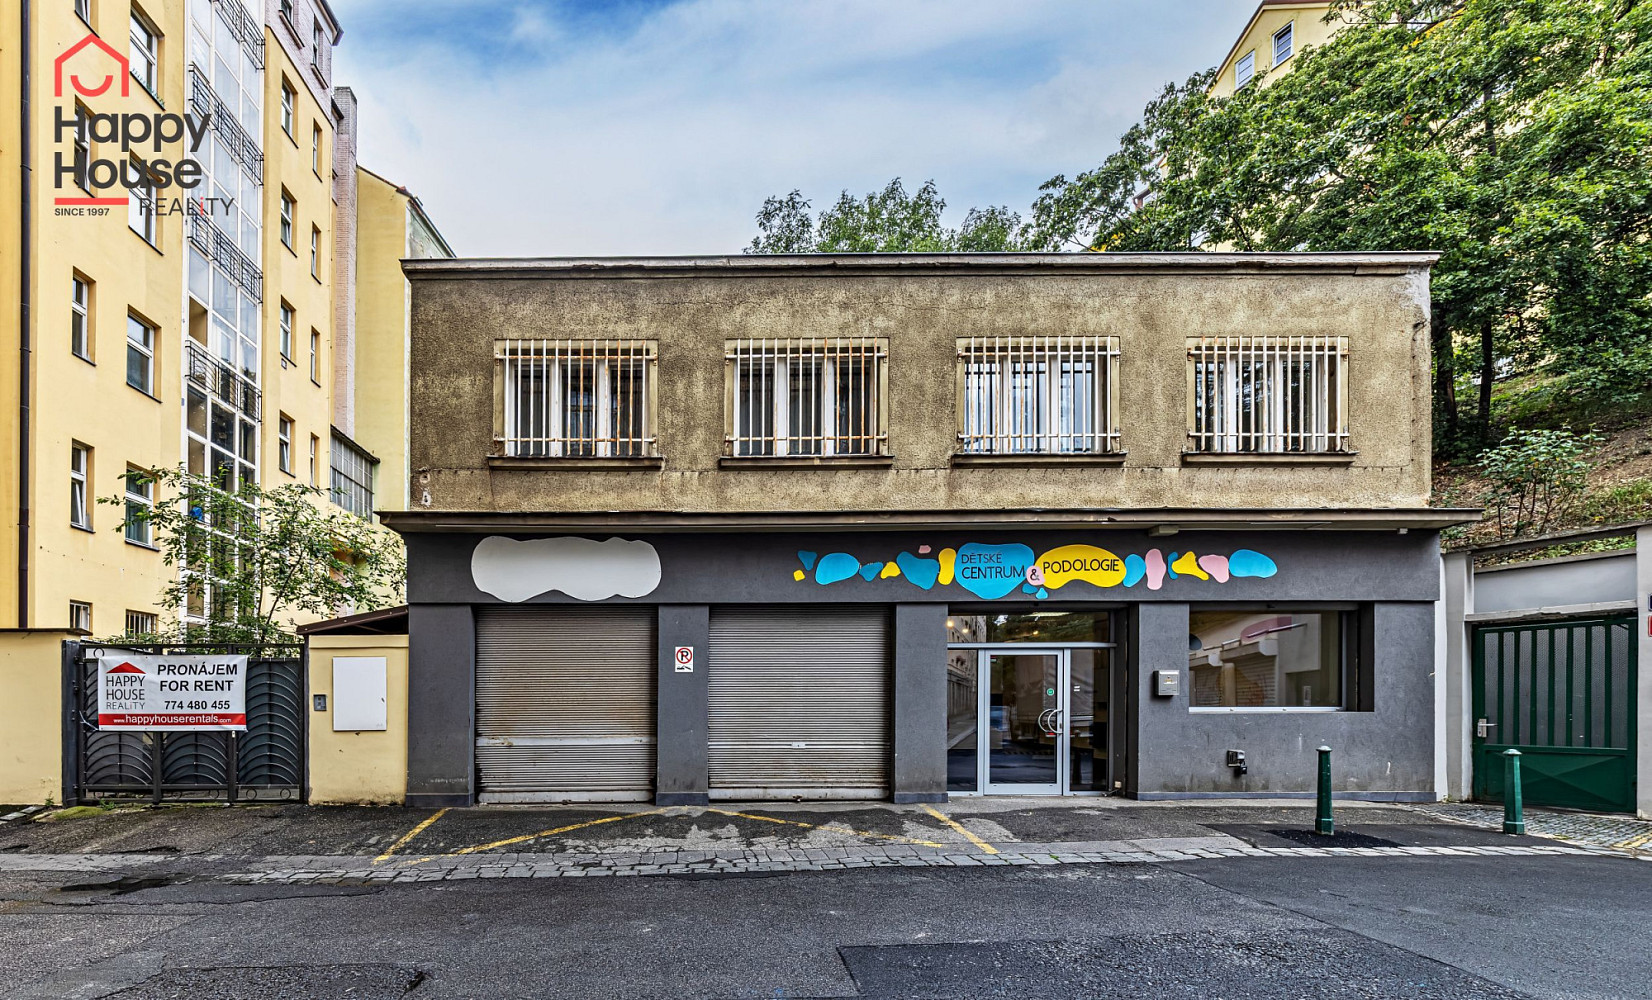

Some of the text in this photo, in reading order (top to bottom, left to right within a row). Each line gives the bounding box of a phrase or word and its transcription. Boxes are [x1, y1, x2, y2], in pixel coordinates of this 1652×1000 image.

[961, 565, 1026, 579] CENTRUM
[1043, 559, 1120, 574] PODOLOGIE
[1029, 568, 1040, 581] &
[157, 662, 238, 675] PRONÁJEM
[105, 675, 146, 687] HAPPY
[159, 680, 234, 691] FOR RENT
[106, 688, 145, 700] HOUSE
[164, 700, 231, 710] 774 480 455
[113, 714, 232, 725] www.happyhouserentals.com
